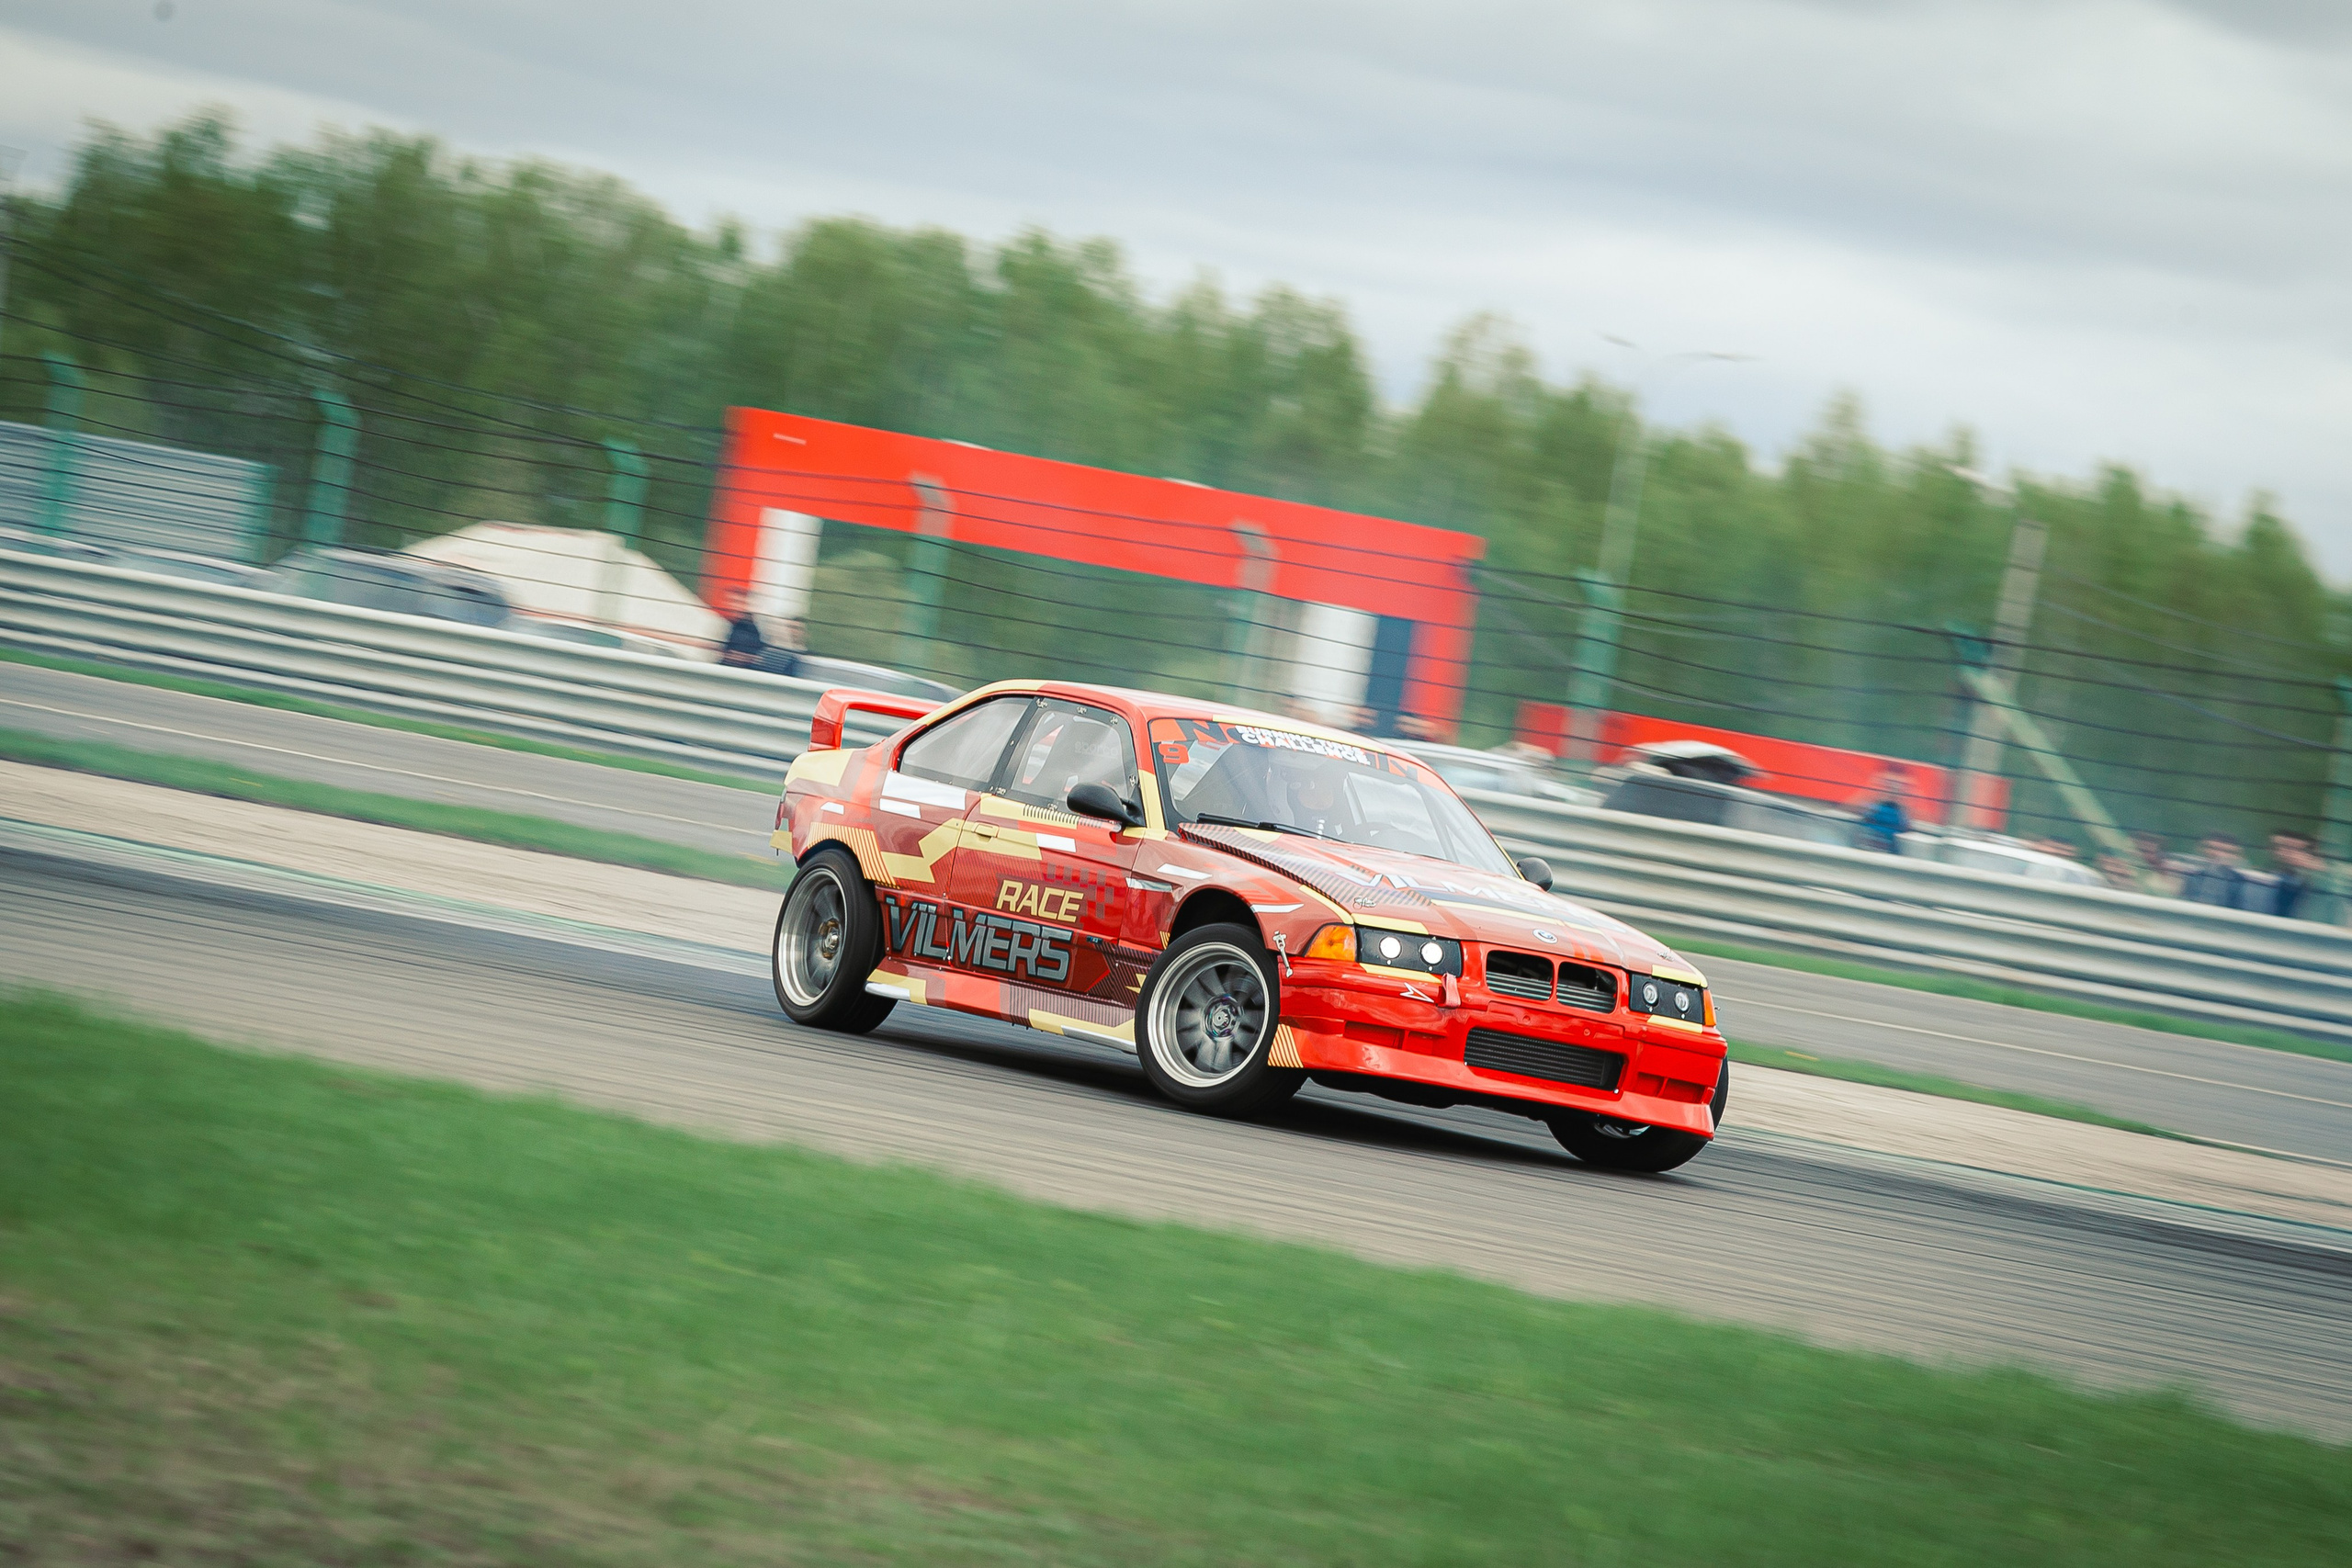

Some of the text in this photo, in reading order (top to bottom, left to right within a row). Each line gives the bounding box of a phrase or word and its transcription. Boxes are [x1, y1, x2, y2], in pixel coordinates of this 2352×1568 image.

[1158, 742, 1190, 764] 9
[1241, 732, 1371, 765] CHALLENGE
[996, 878, 1084, 923] RACE
[885, 896, 1074, 983] VILMERS
